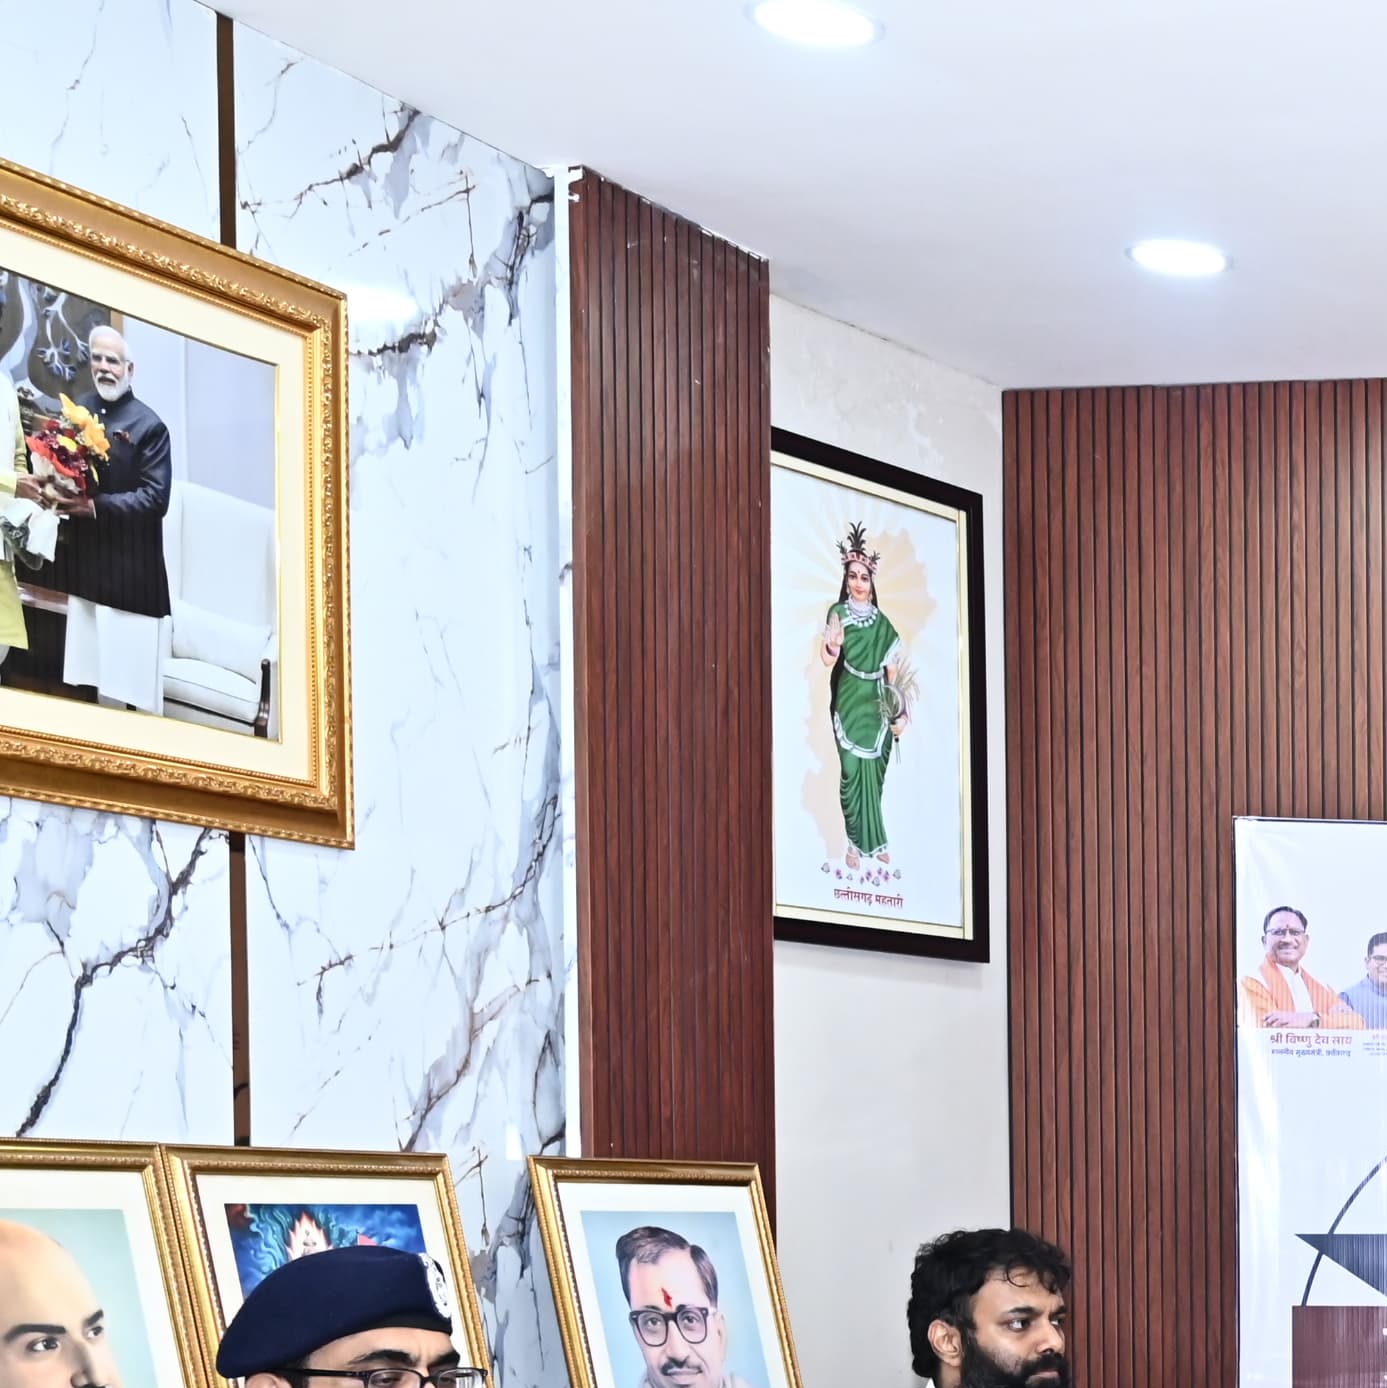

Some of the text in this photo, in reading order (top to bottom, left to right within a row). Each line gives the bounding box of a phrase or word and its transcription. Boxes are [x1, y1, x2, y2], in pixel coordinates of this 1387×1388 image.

[833, 885, 873, 907] छत्तीसगढ़
[1270, 1032, 1283, 1045] श्री
[1285, 1032, 1312, 1048] विष्णु
[1314, 1033, 1330, 1046] देव
